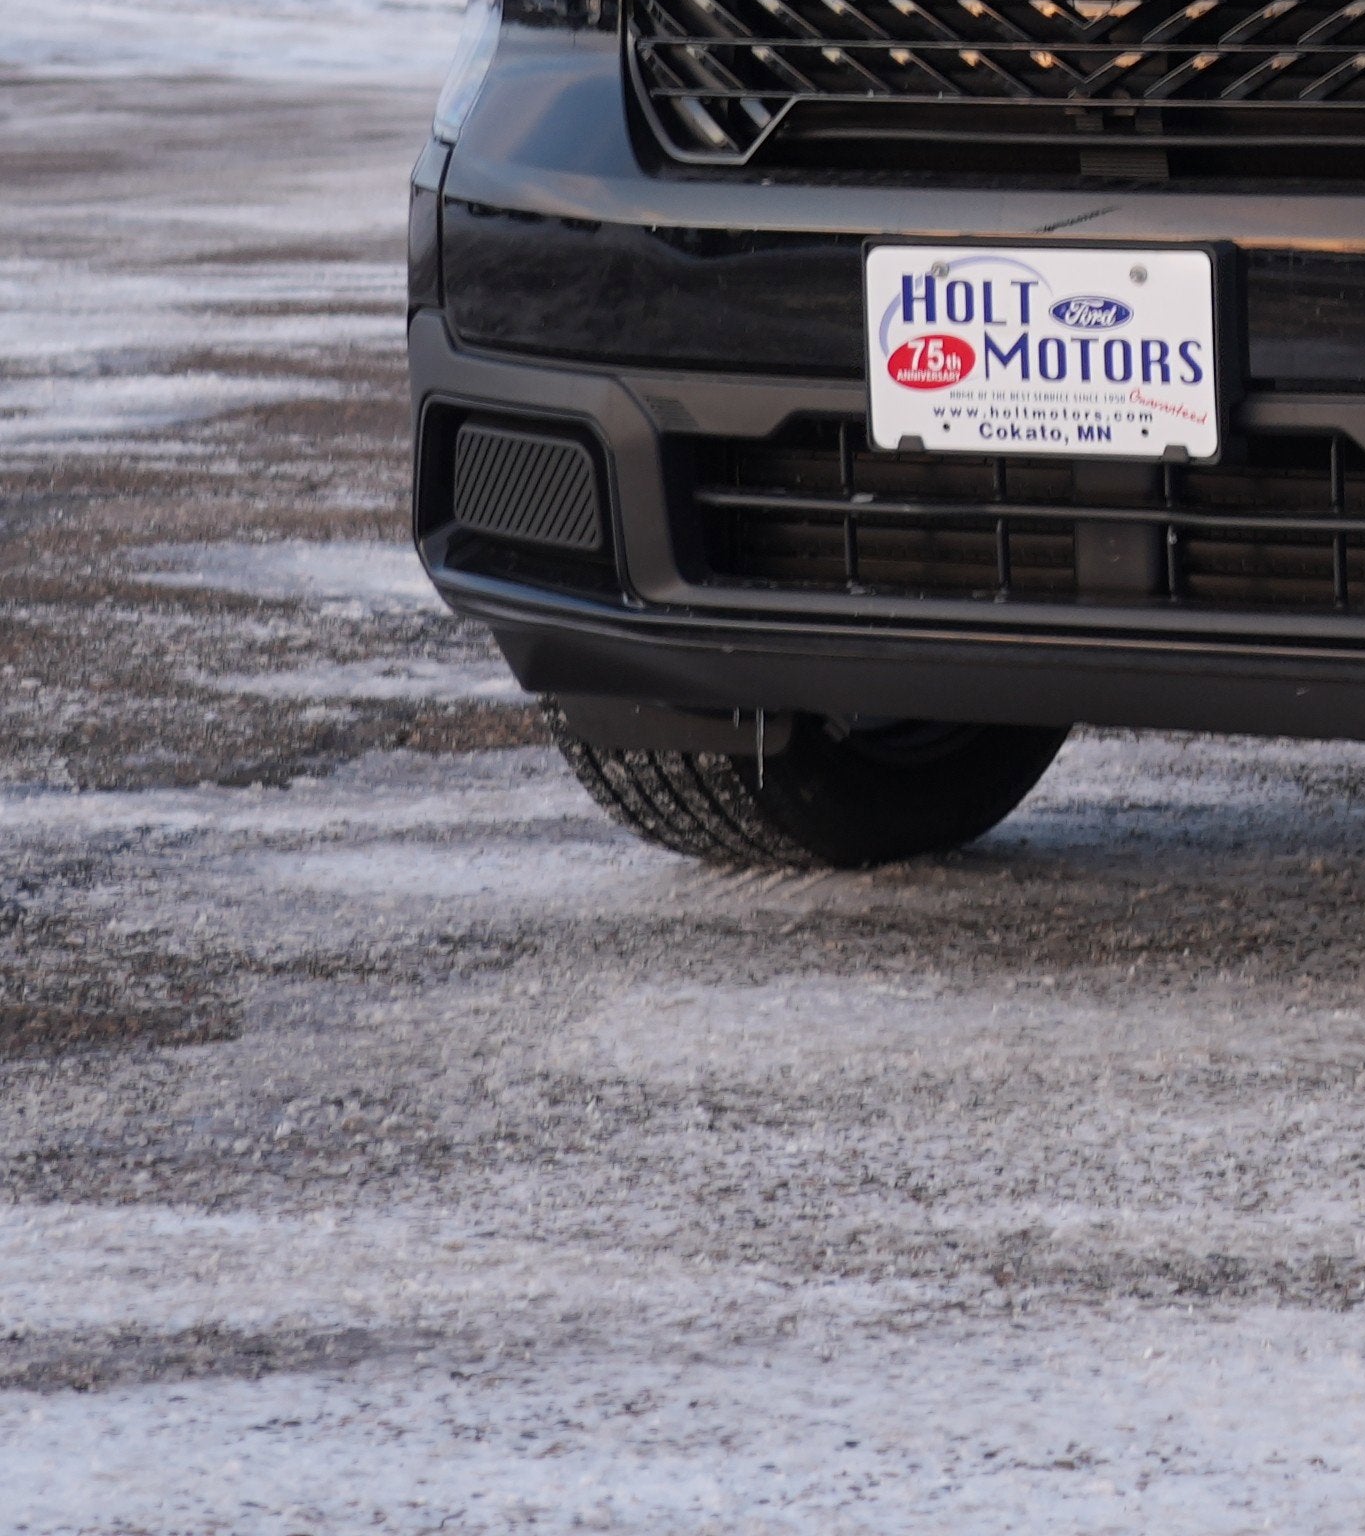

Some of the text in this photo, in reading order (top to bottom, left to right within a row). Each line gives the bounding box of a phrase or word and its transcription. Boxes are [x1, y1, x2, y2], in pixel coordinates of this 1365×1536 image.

[902, 272, 1039, 326] HOLT
[1065, 299, 1118, 327] Ford
[907, 337, 962, 371] 75th
[984, 331, 1204, 386] MOTORS
[933, 405, 1153, 423] www.holtmotors.com
[979, 422, 1112, 445] Cokato, MN
